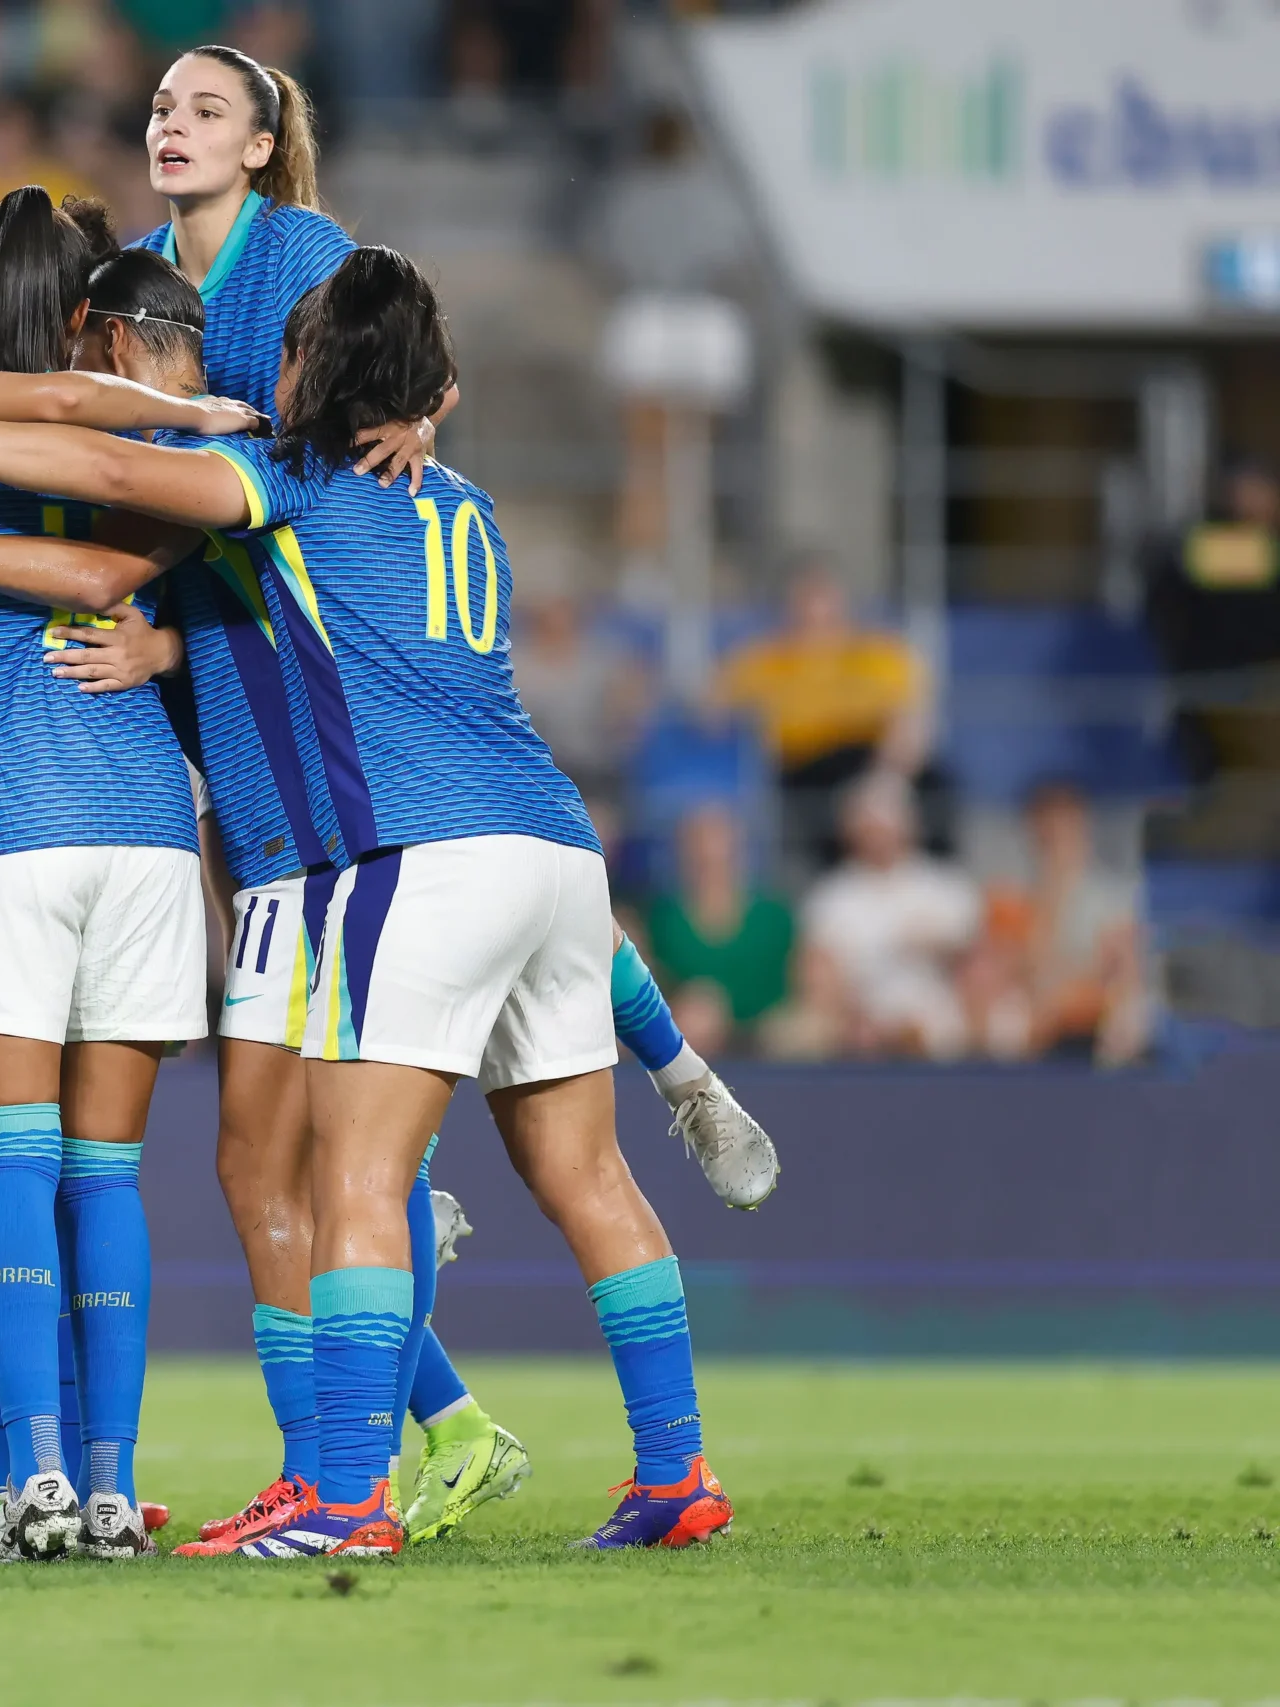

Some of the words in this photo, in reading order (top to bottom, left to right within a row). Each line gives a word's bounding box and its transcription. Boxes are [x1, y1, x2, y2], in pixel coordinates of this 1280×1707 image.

[413, 497, 498, 656] 10
[235, 896, 280, 975] 11
[73, 1291, 135, 1310] BRASIL
